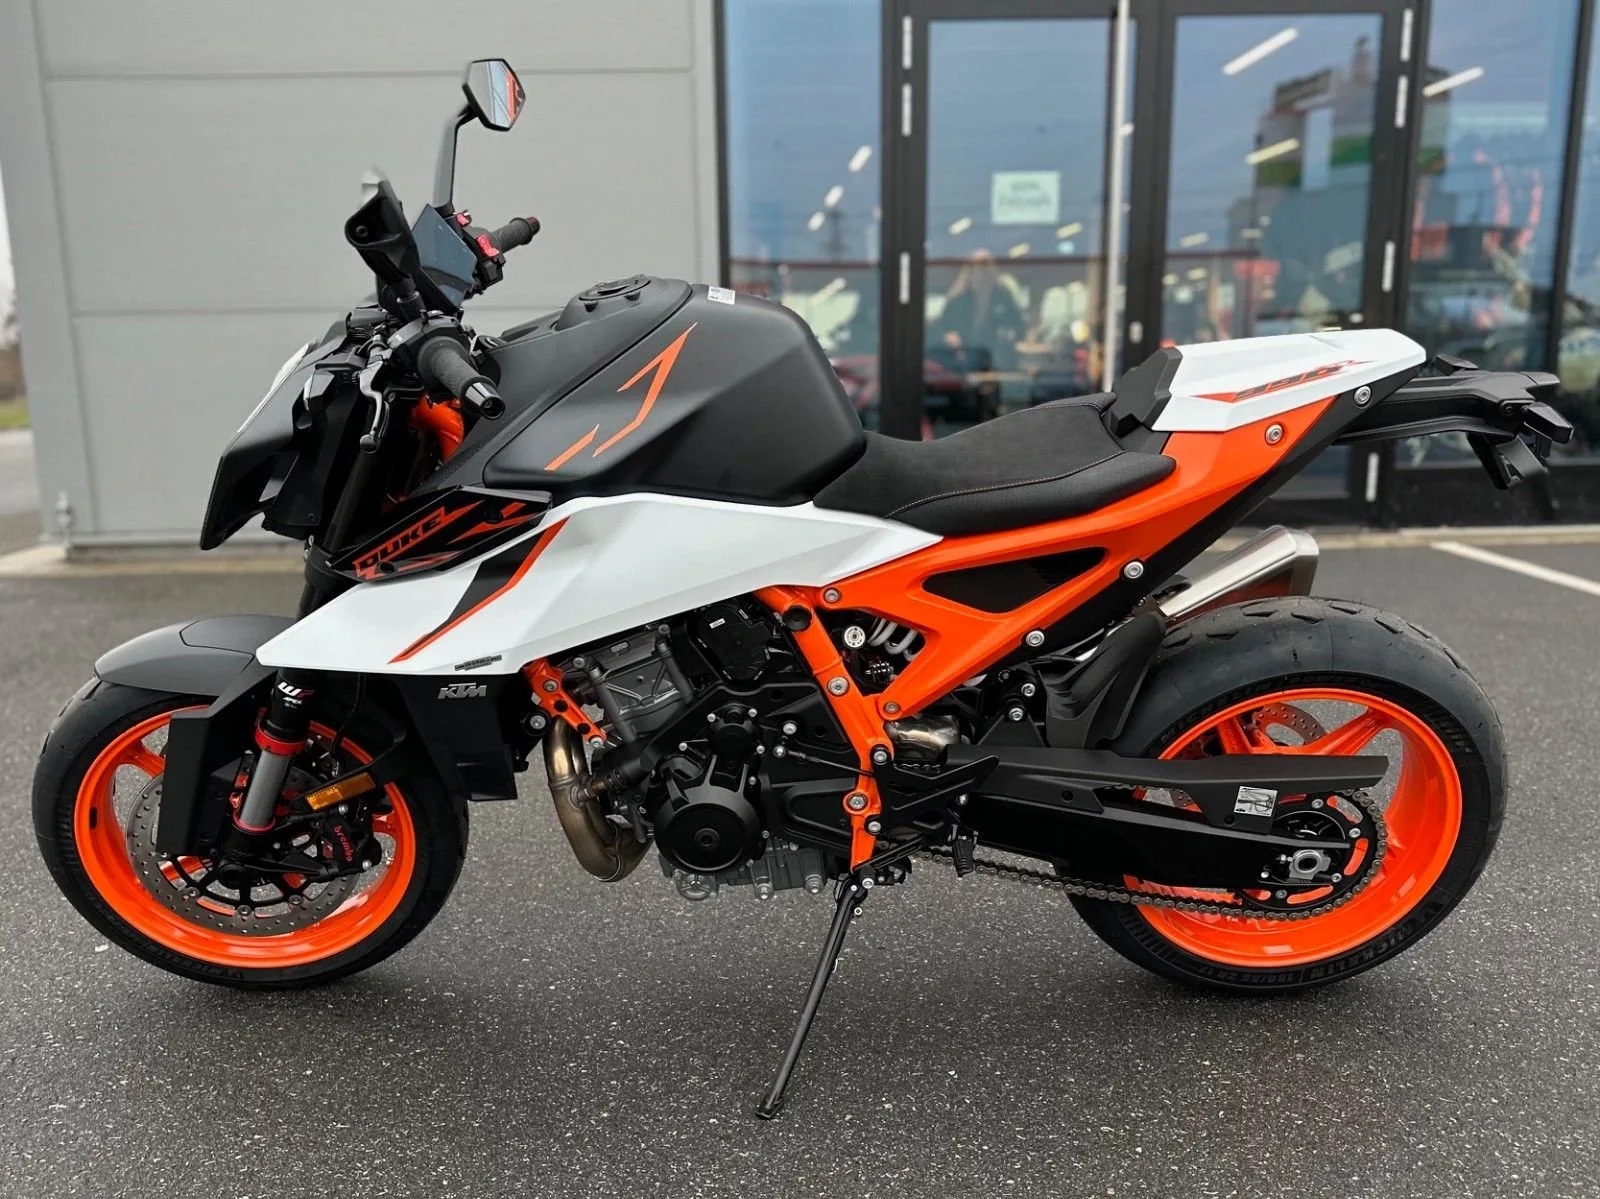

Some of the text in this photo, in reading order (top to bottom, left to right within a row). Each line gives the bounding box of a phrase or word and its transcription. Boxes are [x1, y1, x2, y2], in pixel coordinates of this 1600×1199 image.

[355, 512, 446, 570] DUKE
[438, 683, 487, 699] KTM
[334, 825, 353, 862] brembo
